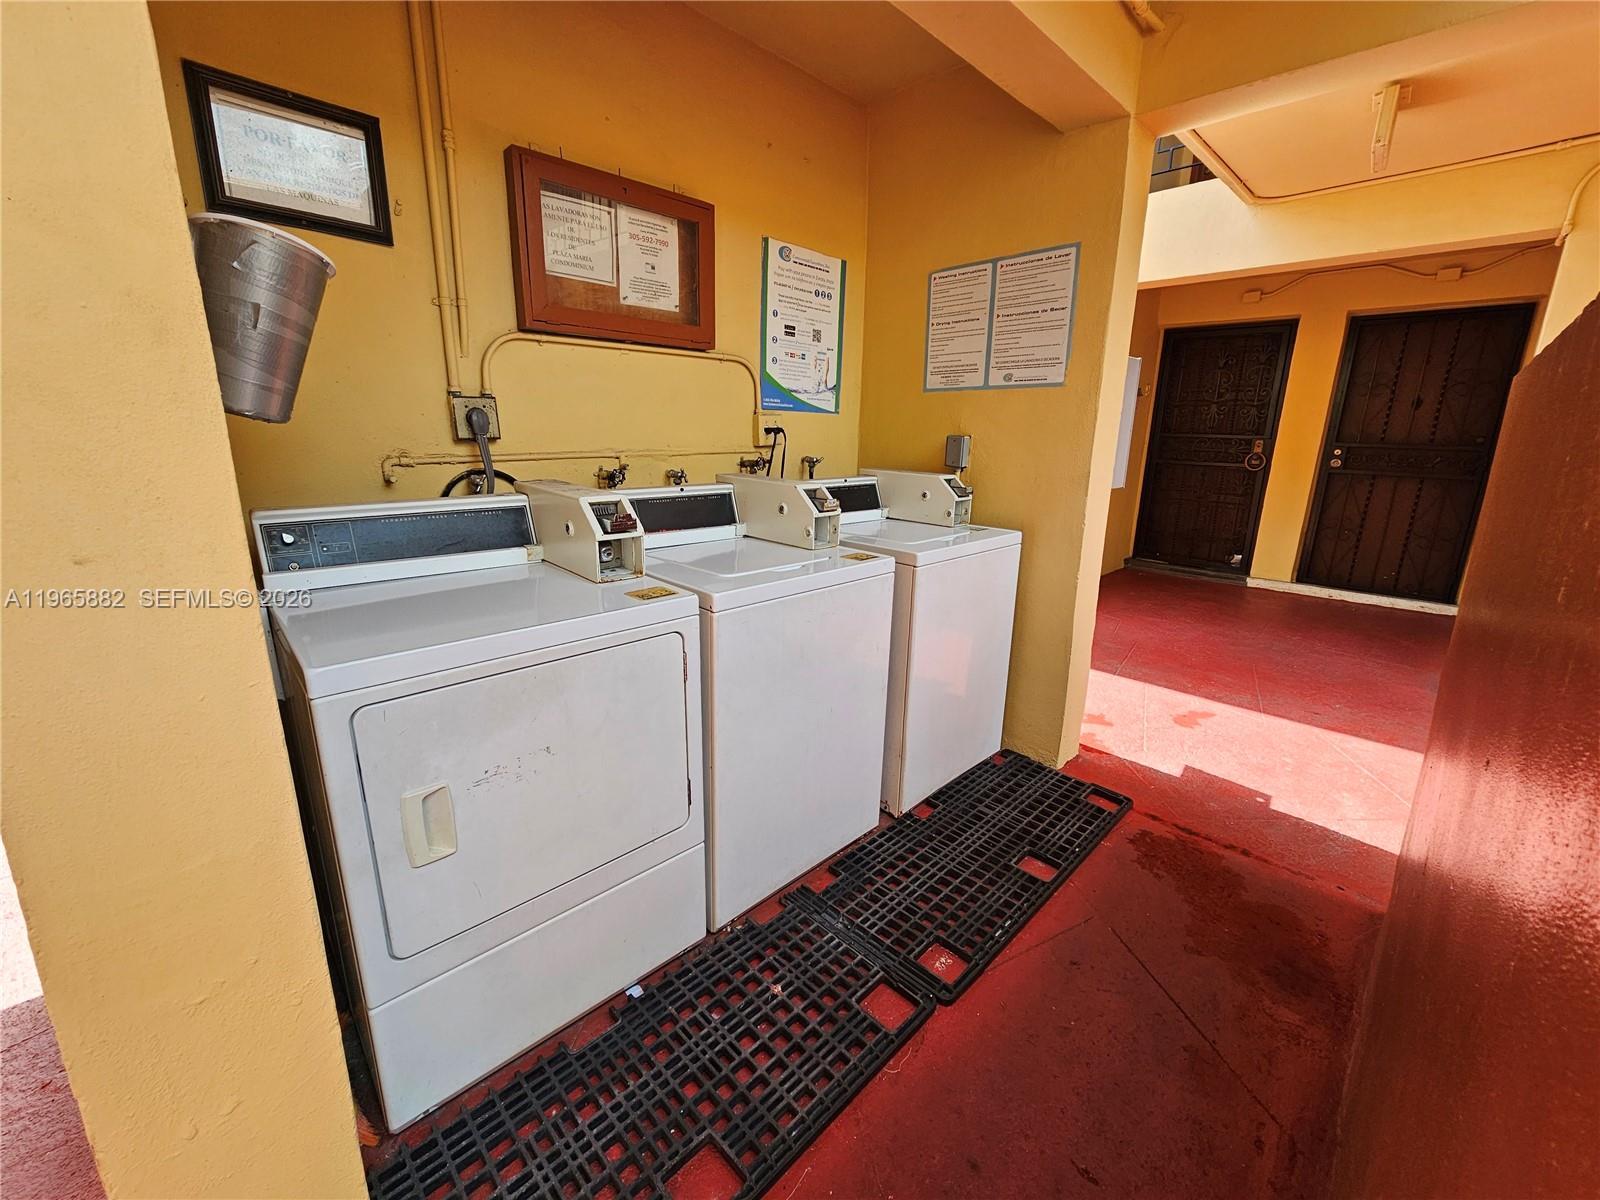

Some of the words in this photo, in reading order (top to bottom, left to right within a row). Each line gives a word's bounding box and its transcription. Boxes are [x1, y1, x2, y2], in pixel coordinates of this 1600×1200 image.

[286, 134, 349, 163] FOR
[551, 204, 588, 218] LAVADORAS
[560, 233, 596, 246] RESIDENTES
[552, 249, 572, 258] PLAZA
[550, 258, 595, 272] CONDOMINIUM
[1005, 256, 1044, 268] Instrucciones
